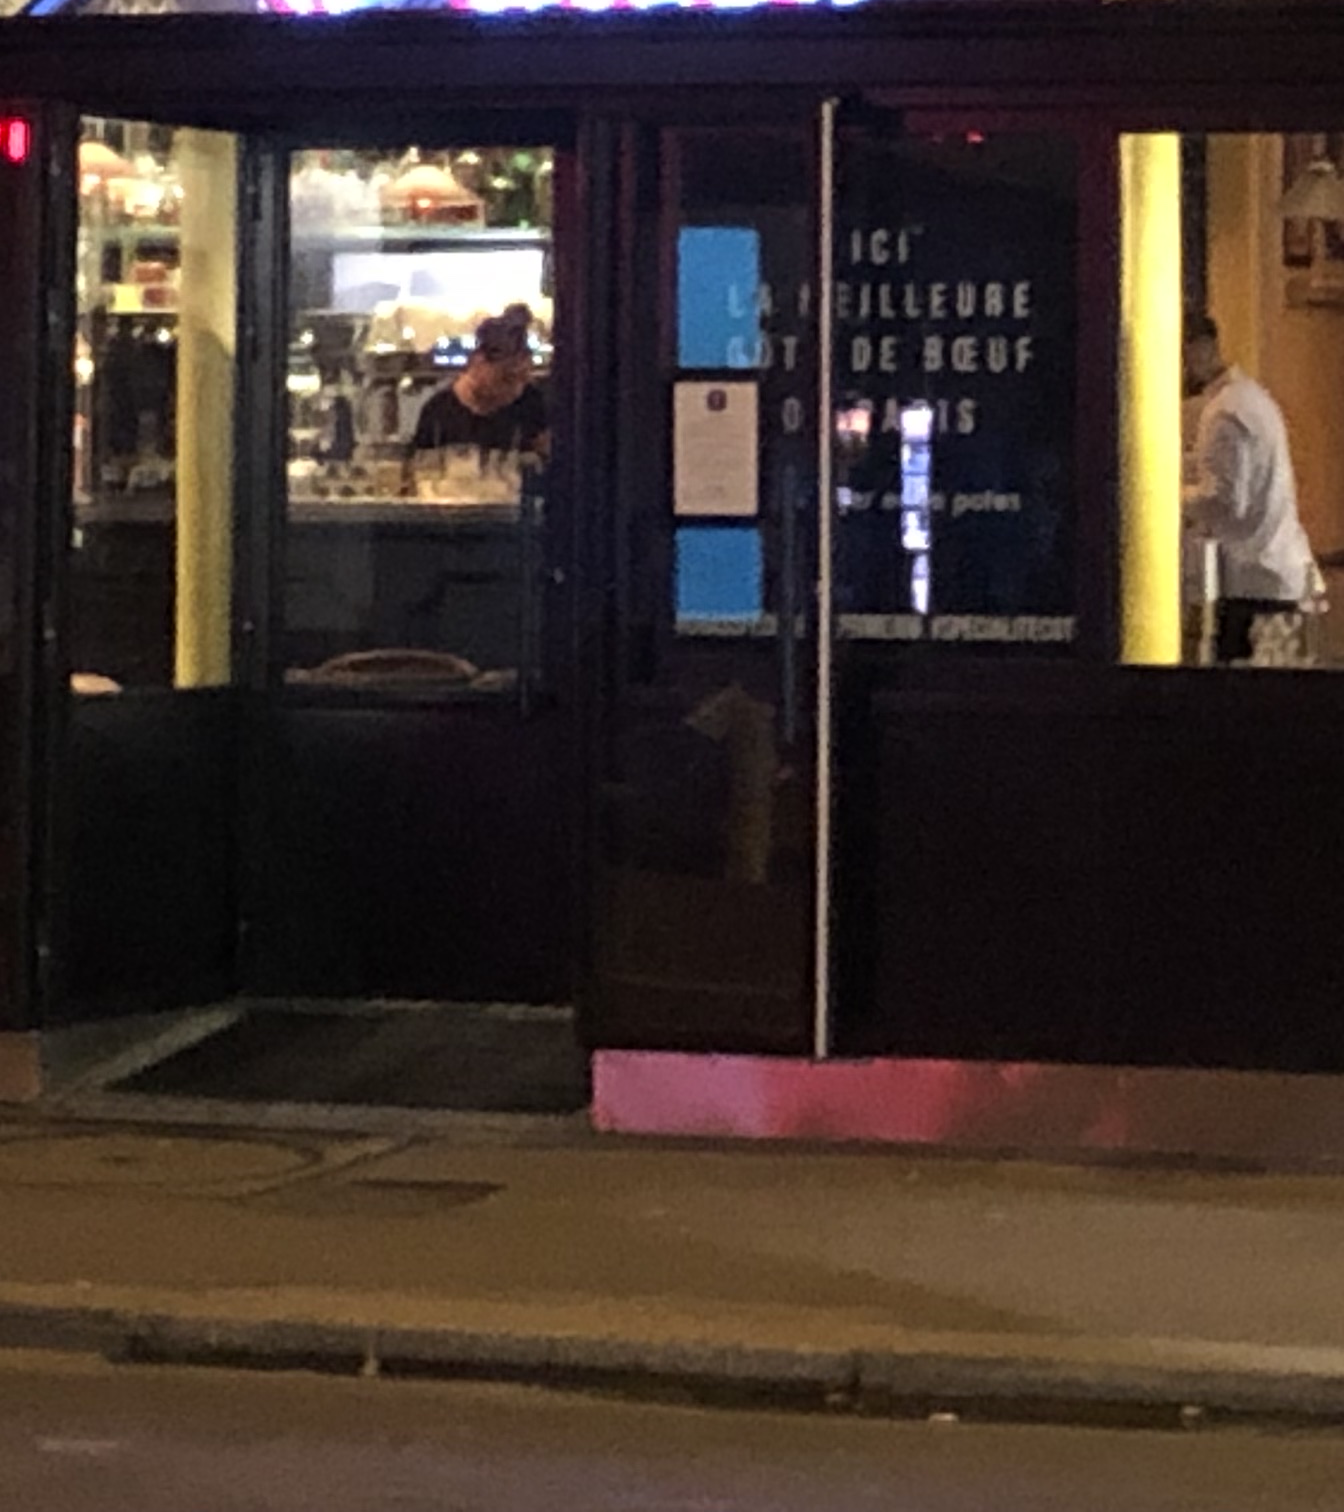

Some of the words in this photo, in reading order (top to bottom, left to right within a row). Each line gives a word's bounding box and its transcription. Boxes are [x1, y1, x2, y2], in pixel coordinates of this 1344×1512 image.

[850, 227, 910, 266] ICI
[851, 335, 898, 373] DE
[922, 335, 1034, 373] BŒUF
[856, 396, 975, 434] AIS
